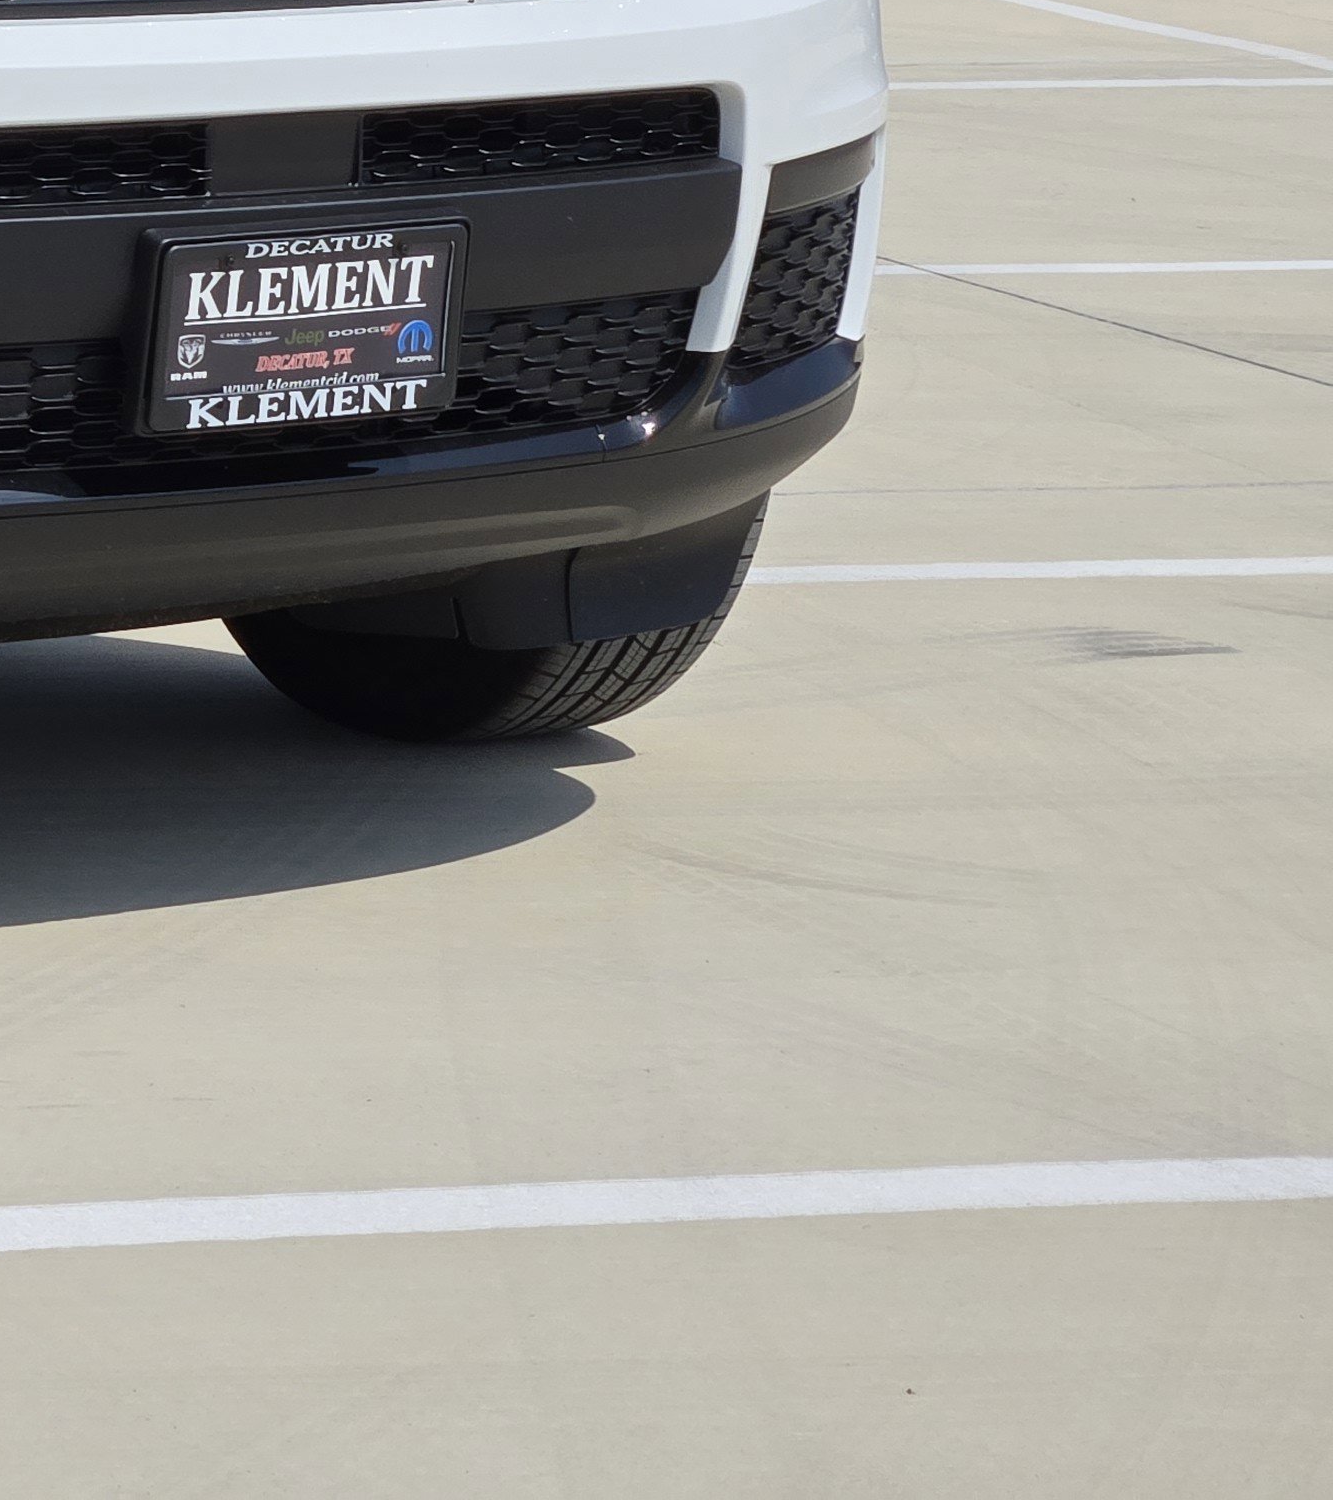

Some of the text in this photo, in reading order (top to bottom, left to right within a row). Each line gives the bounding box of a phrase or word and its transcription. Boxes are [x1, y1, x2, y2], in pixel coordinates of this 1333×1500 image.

[245, 233, 394, 258] DECATUR
[184, 255, 435, 320] KLEMENT
[285, 328, 325, 345] Jeep
[328, 324, 391, 338] DODGE
[255, 347, 355, 372] DECATUR, TX
[170, 371, 208, 381] RAM
[186, 380, 428, 429] KLEMENT
